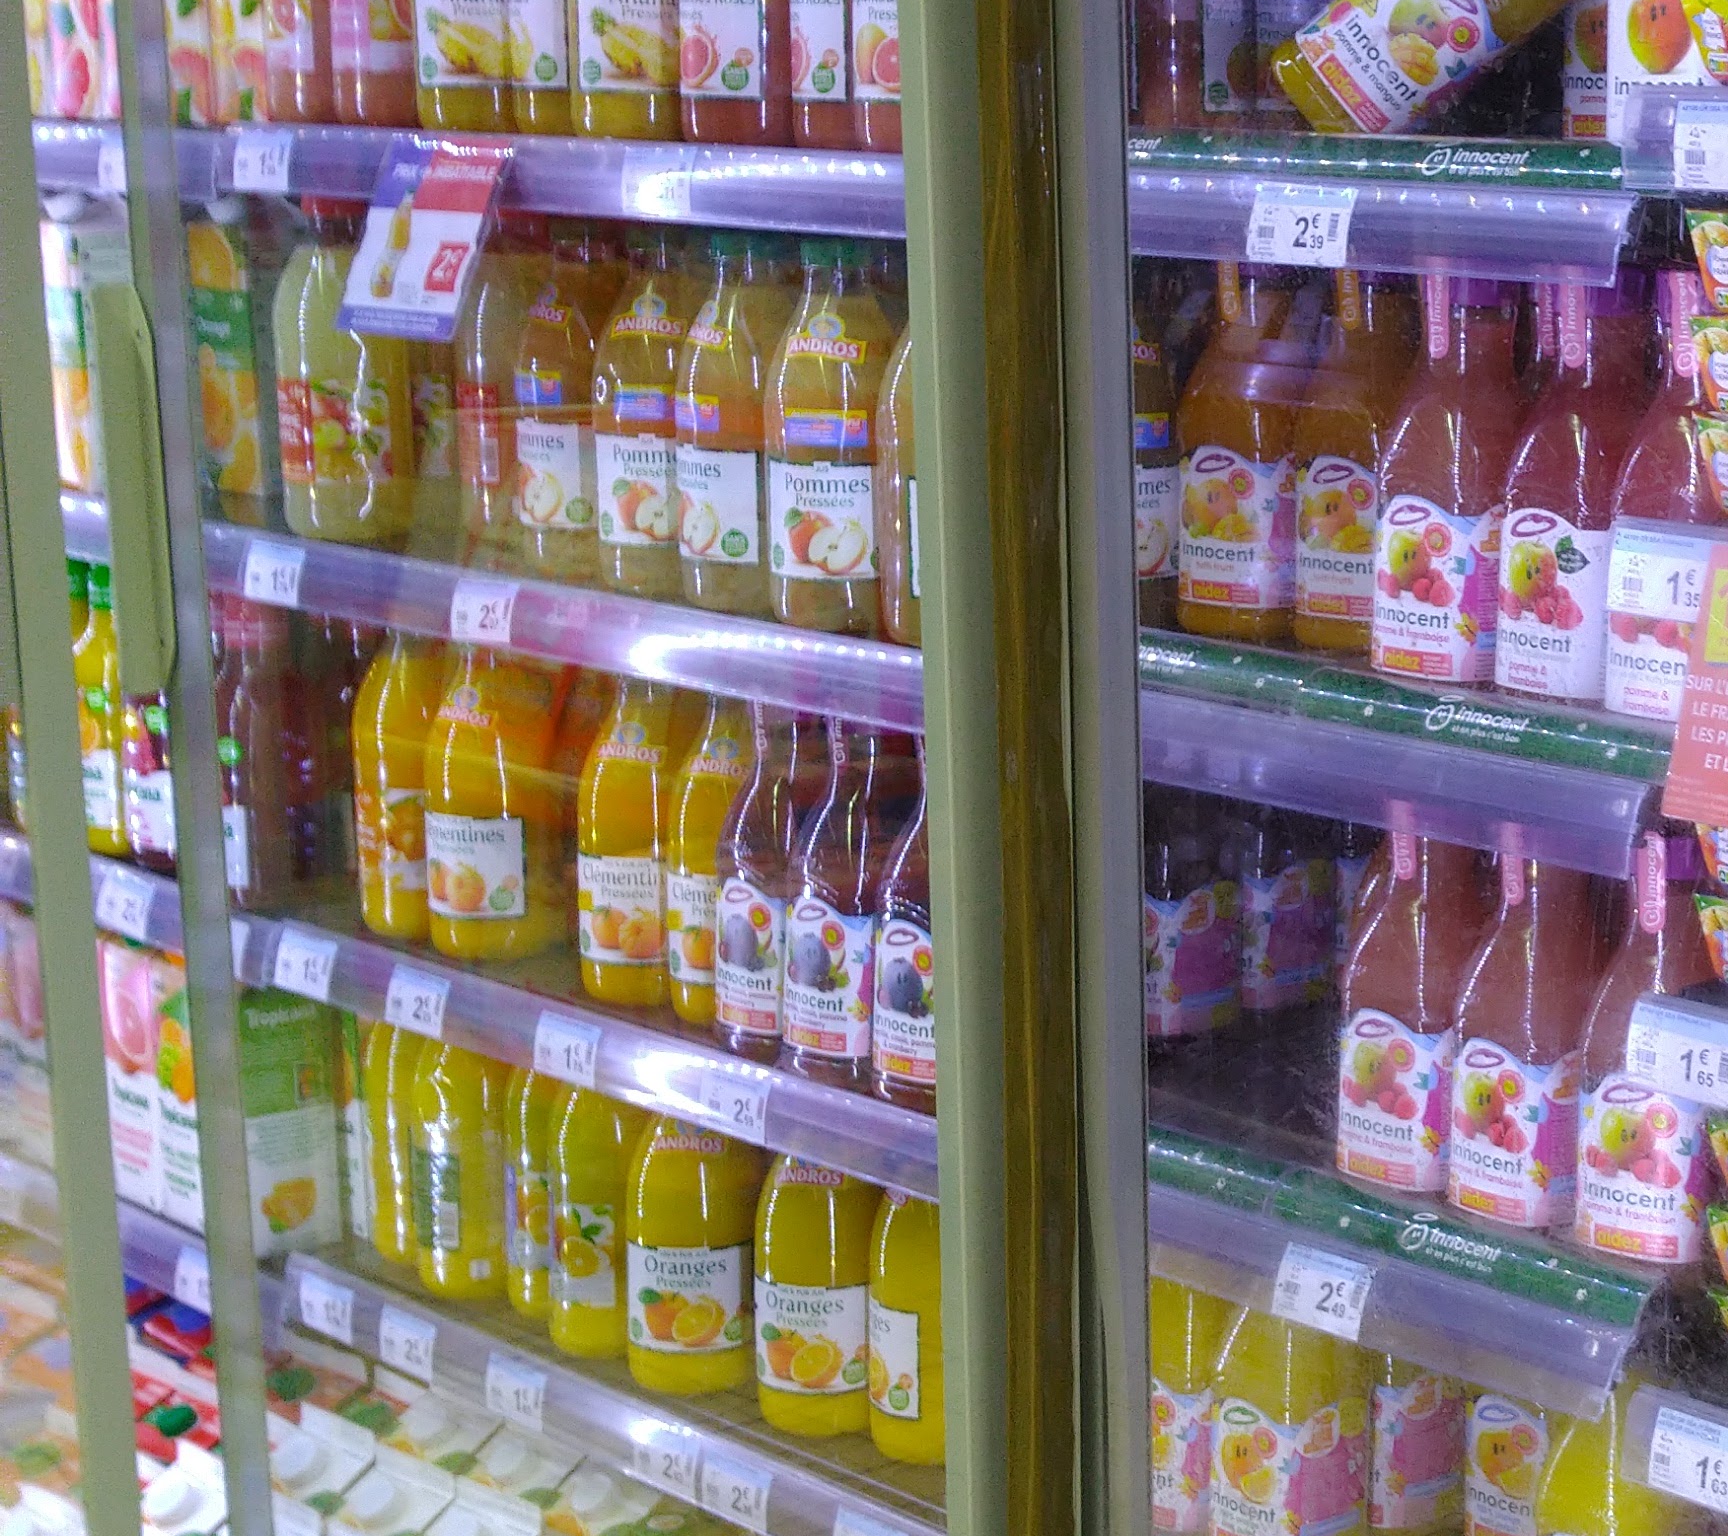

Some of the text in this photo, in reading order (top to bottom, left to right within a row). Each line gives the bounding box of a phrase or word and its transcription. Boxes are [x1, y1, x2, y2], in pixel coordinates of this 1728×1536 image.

[1345, 14, 1418, 101] innocent
[1452, 149, 1530, 164] innocent
[789, 339, 858, 359] ANDROS
[785, 475, 869, 494] Pommes
[1376, 600, 1449, 628] innocent
[1686, 675, 1713, 691] SUR
[1693, 702, 1709, 715] LE
[1691, 726, 1714, 743] LES
[1705, 753, 1720, 769] ET
[1584, 1177, 1676, 1211] innocent
[644, 1254, 726, 1278] Oranges
[766, 1291, 844, 1315] Oranges
